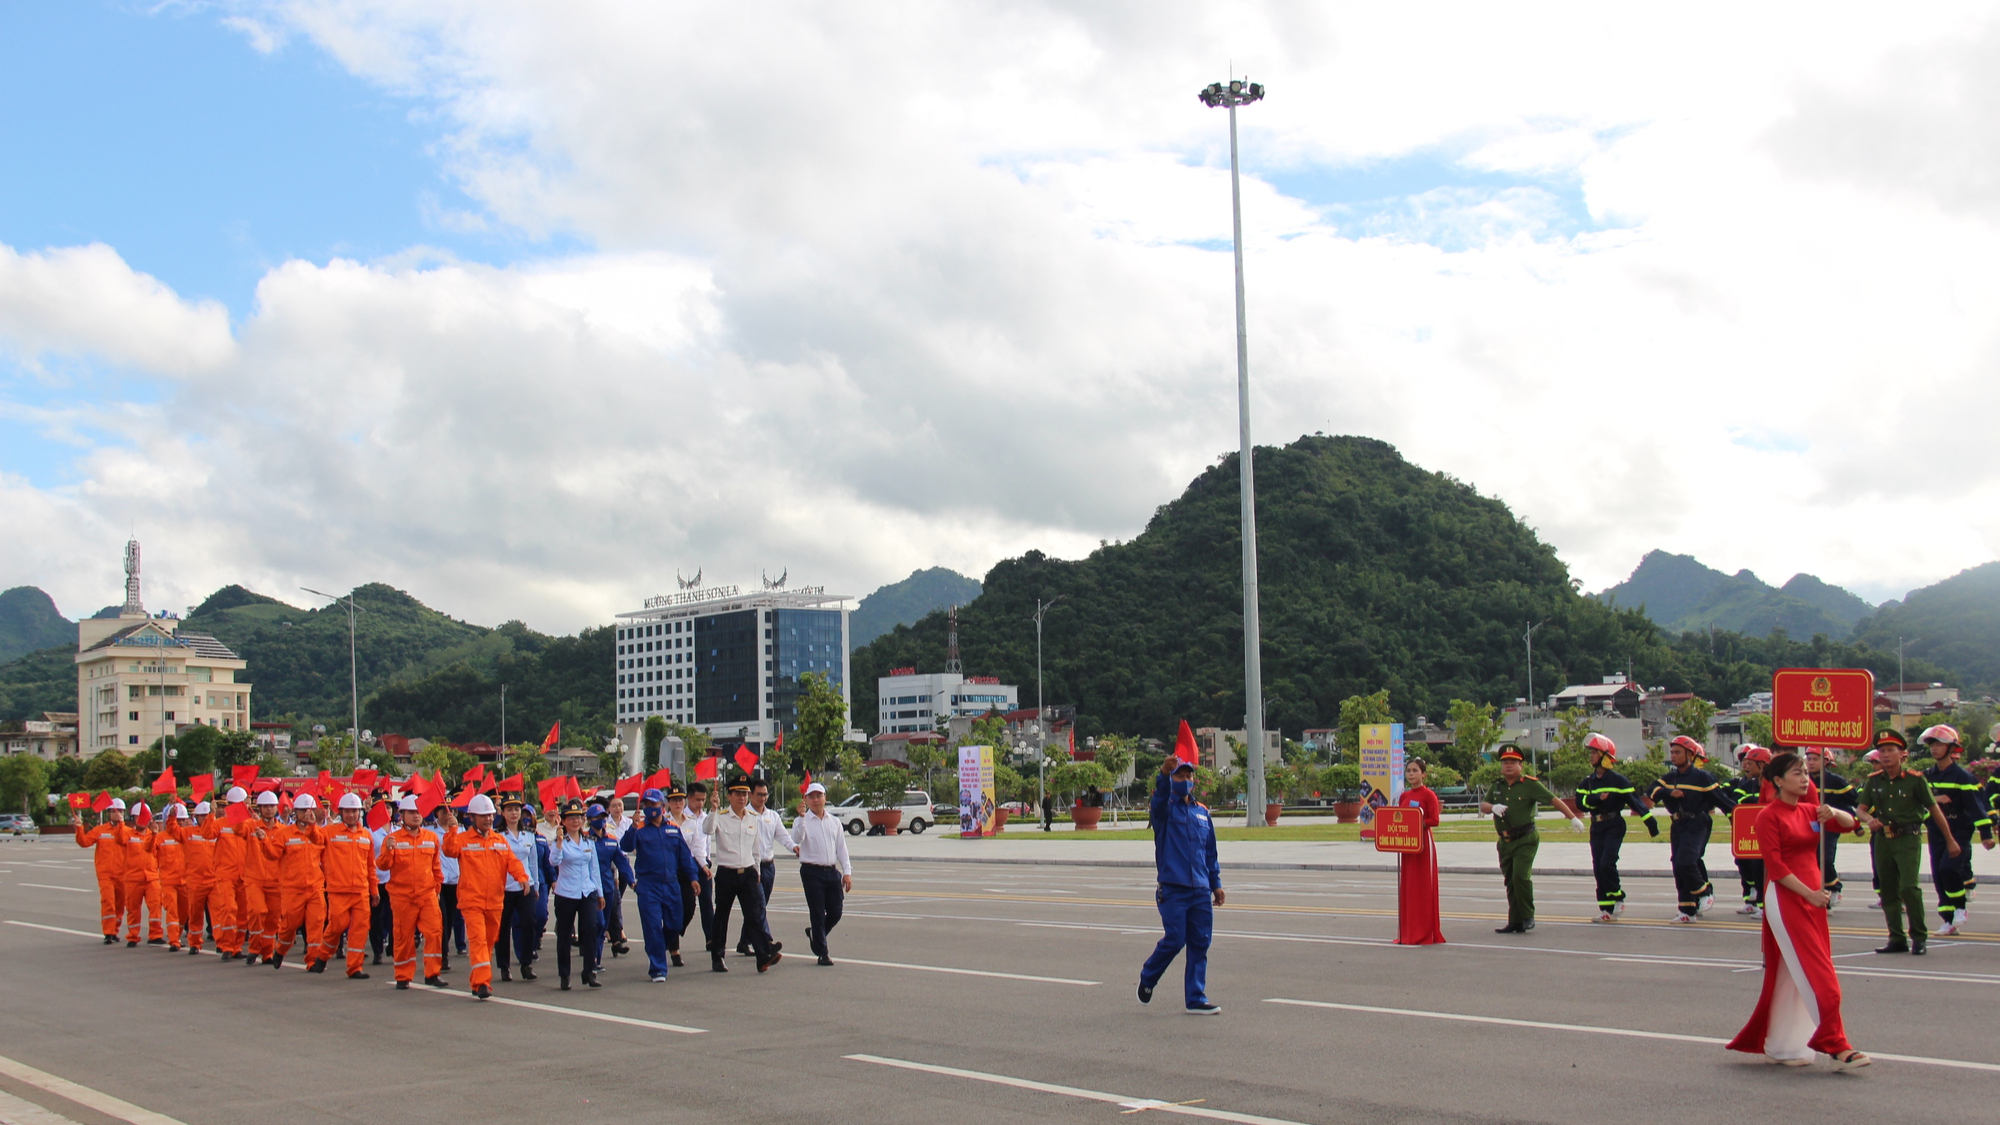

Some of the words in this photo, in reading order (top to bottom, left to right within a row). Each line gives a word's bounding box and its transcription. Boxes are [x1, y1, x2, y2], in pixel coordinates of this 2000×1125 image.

[674, 589, 704, 604] THANH
[1803, 696, 1839, 713] KHỐI
[1781, 718, 1795, 738] LỰC
[1796, 719, 1819, 739] LƯỢNG
[1820, 721, 1839, 737] PCCC
[1840, 721, 1851, 738] CƠ
[1851, 715, 1863, 738] SỞ
[1738, 837, 1751, 851] CÔNG
